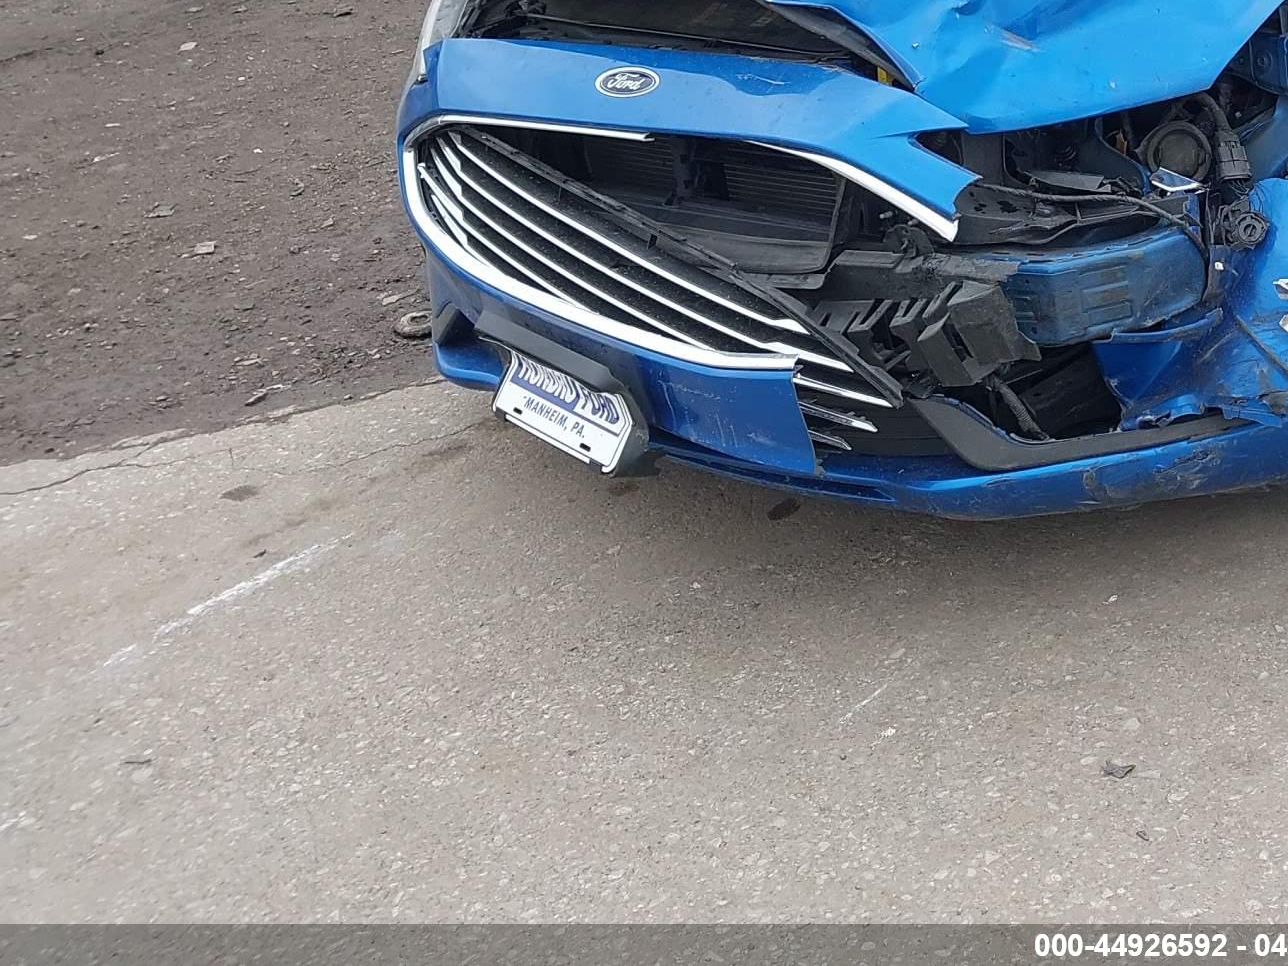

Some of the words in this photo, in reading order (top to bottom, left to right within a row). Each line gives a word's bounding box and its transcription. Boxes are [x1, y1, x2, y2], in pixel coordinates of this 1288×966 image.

[607, 73, 645, 90] Ford
[523, 397, 568, 432] MANHEIM,
[570, 422, 586, 439] PA.
